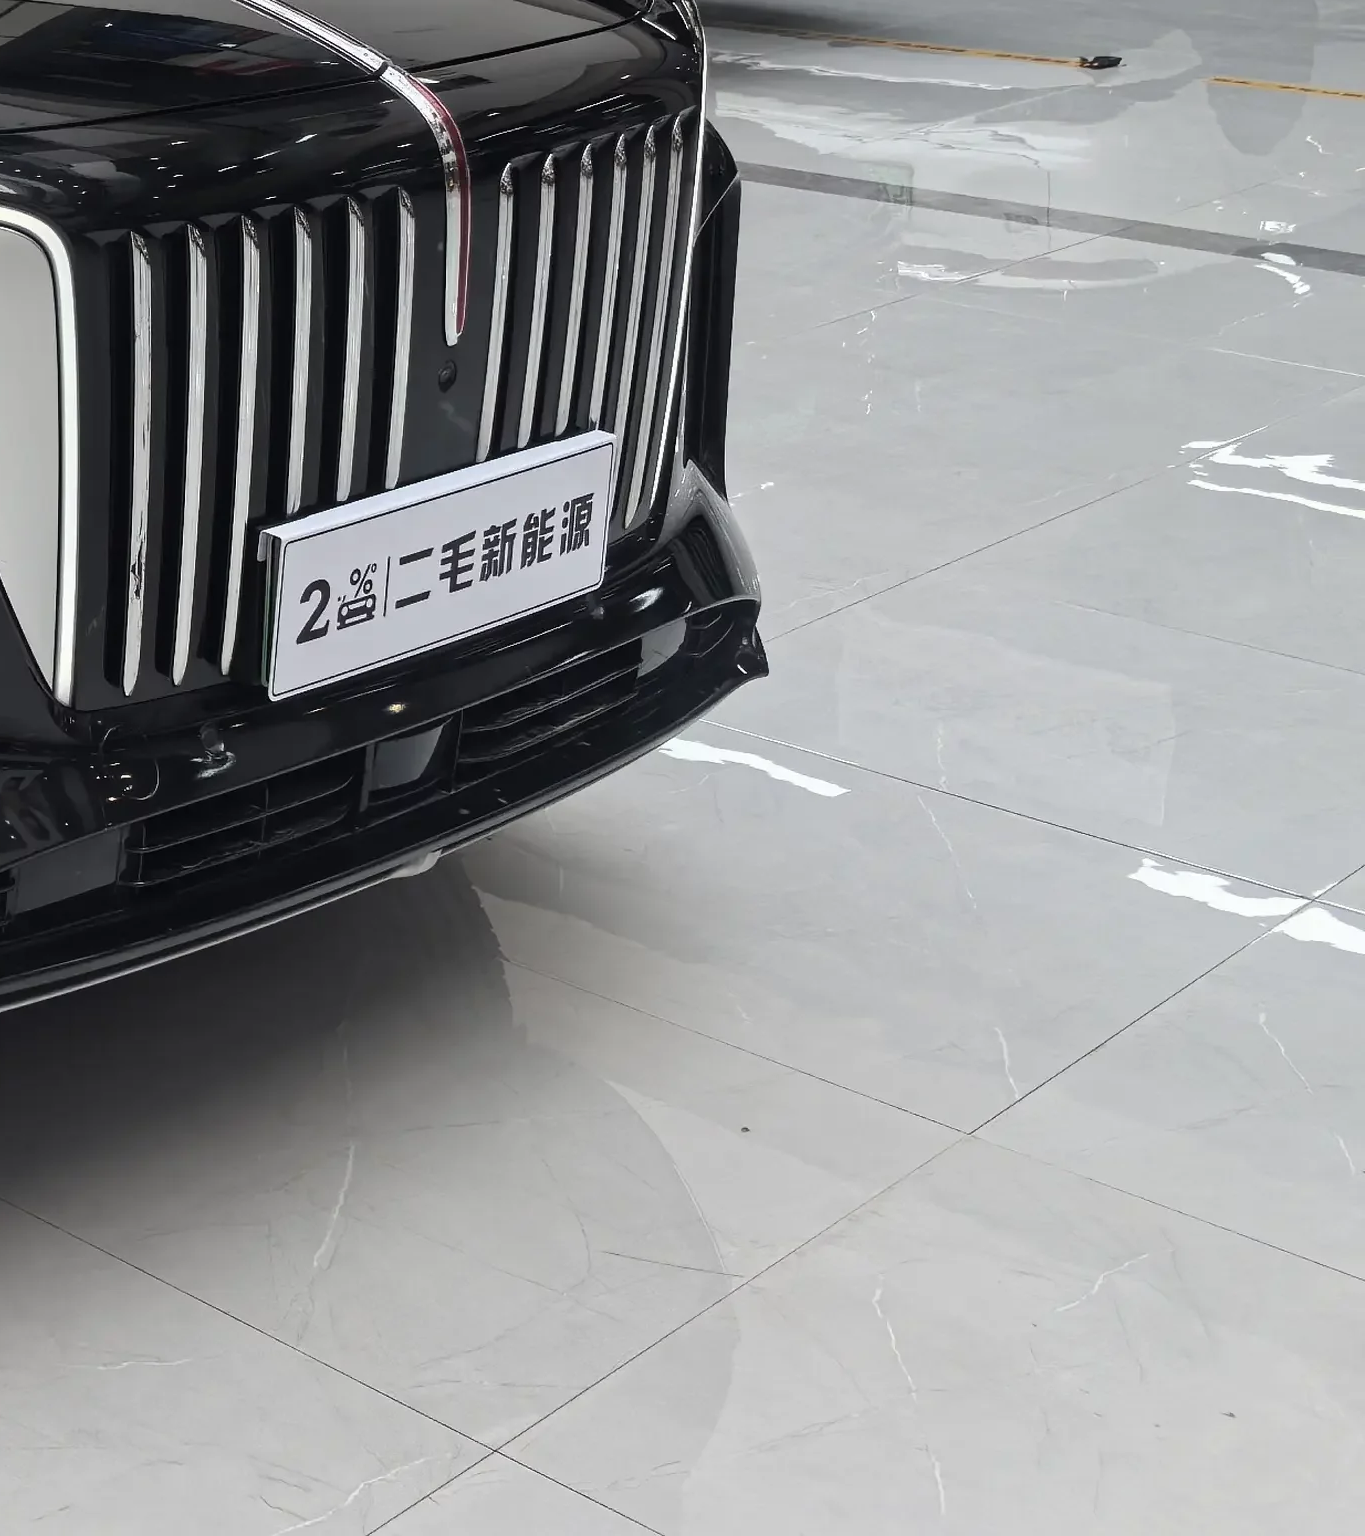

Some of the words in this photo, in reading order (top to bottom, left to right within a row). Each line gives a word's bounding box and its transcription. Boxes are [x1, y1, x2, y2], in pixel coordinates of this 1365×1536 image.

[395, 492, 595, 610] 二毛新能源
